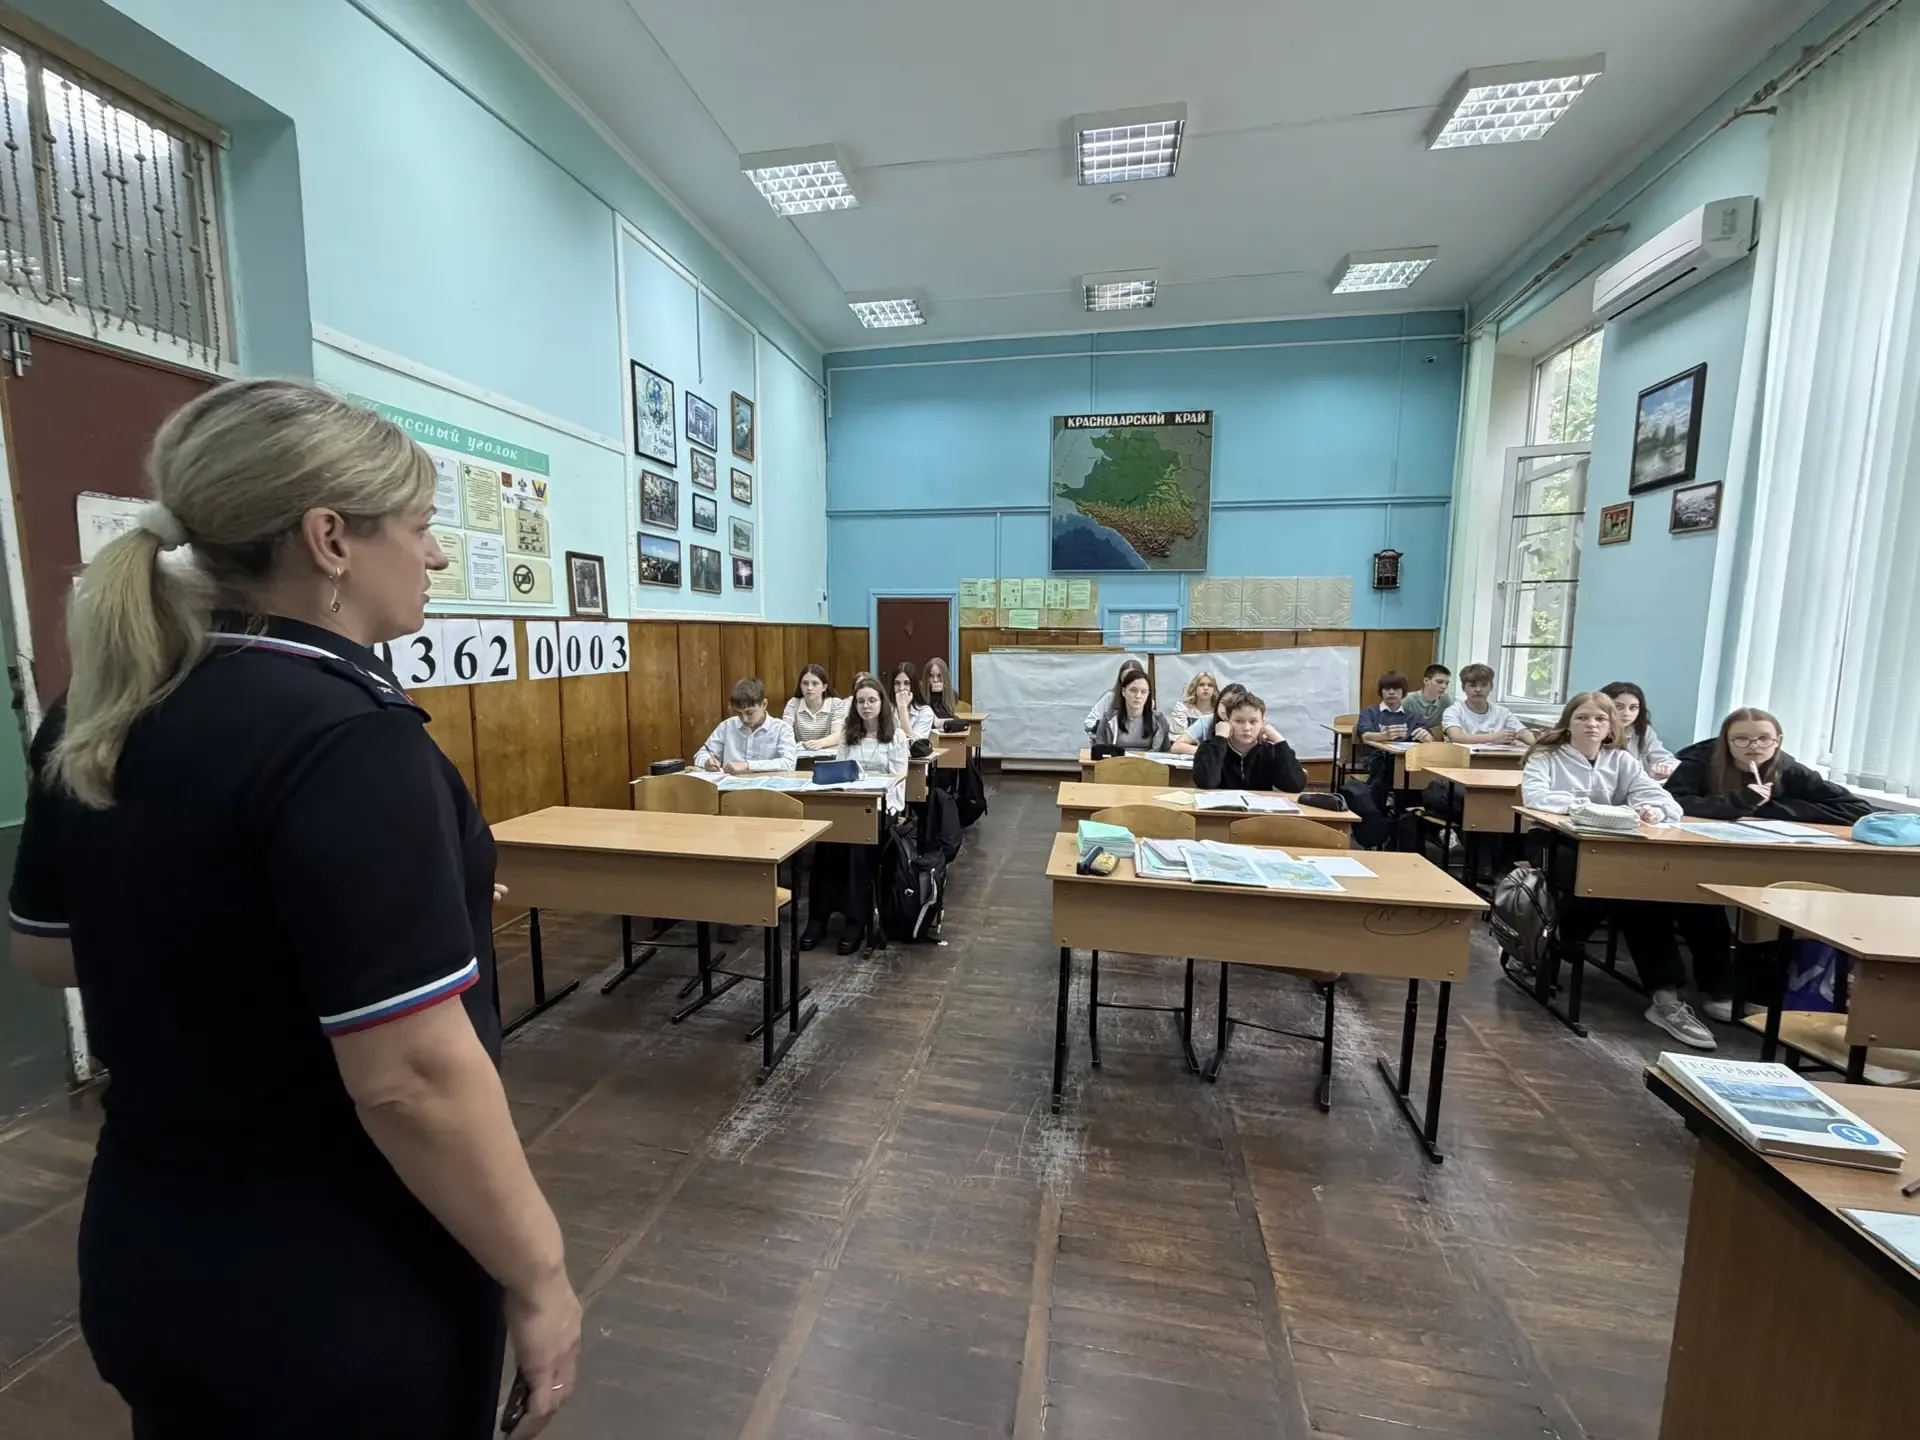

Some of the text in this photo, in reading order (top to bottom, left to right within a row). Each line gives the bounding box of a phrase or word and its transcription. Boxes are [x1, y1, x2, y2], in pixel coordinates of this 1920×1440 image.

[1067, 411, 1206, 428] КРАСНОДАРСКИЙ КРАЙ
[467, 436, 518, 460] уголок
[535, 634, 628, 675] 0003
[1679, 1060, 1789, 1079] ГЕОГРАФИЯ
